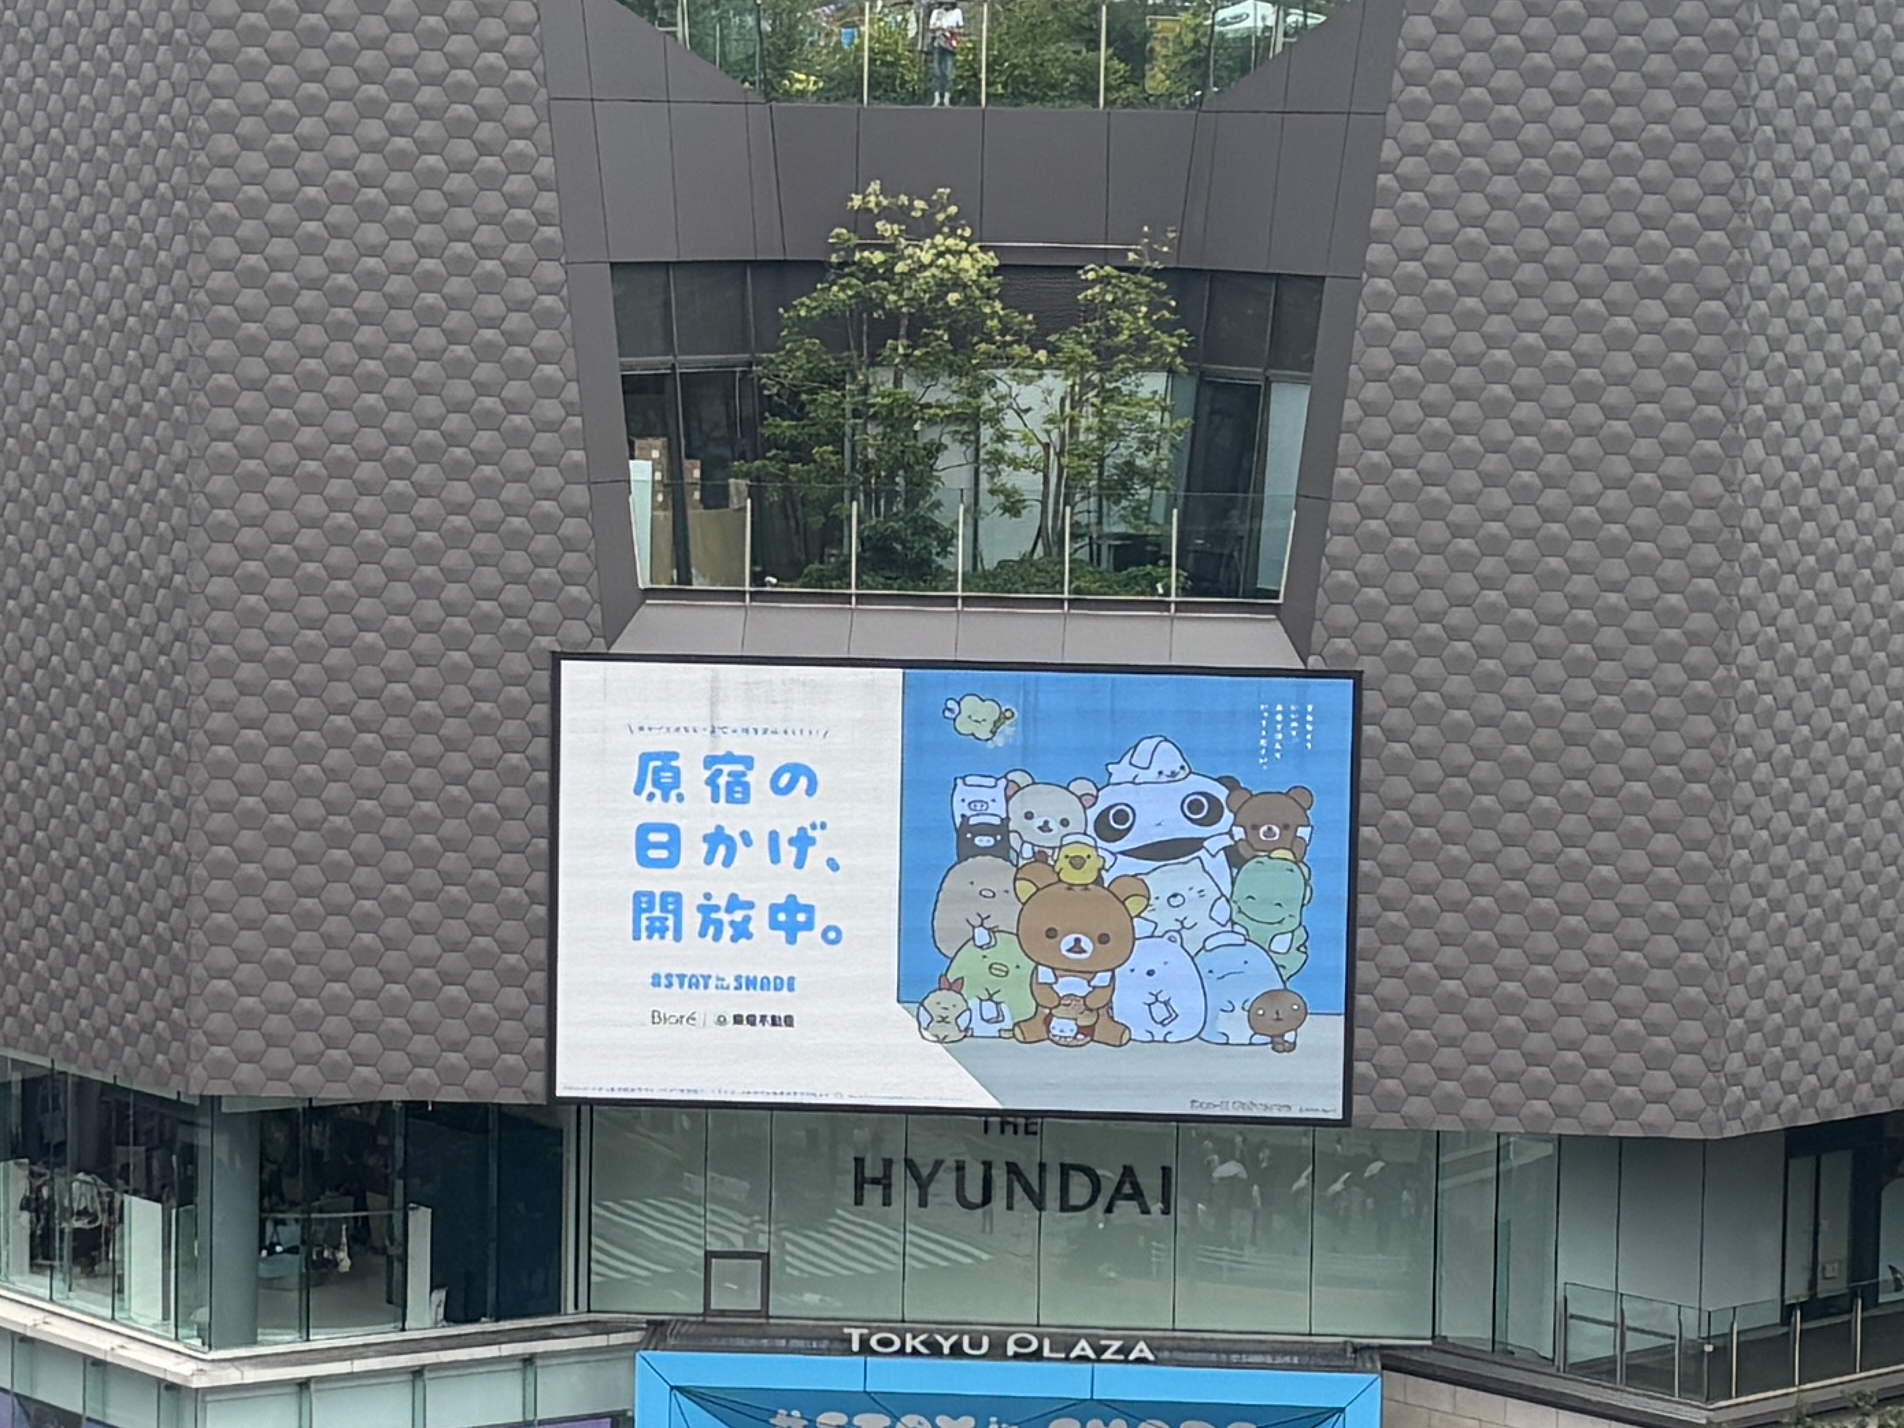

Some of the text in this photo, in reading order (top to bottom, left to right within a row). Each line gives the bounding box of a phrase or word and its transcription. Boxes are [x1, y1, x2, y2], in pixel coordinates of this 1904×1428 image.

[633, 751, 819, 805] 原宿の
[635, 821, 840, 872] 日かげ、
[632, 890, 843, 946] 開放中。
[982, 1118, 1039, 1138] THE
[853, 1156, 1174, 1217] HYUNDAI
[843, 1328, 1156, 1362] TOKYU PLAZA
